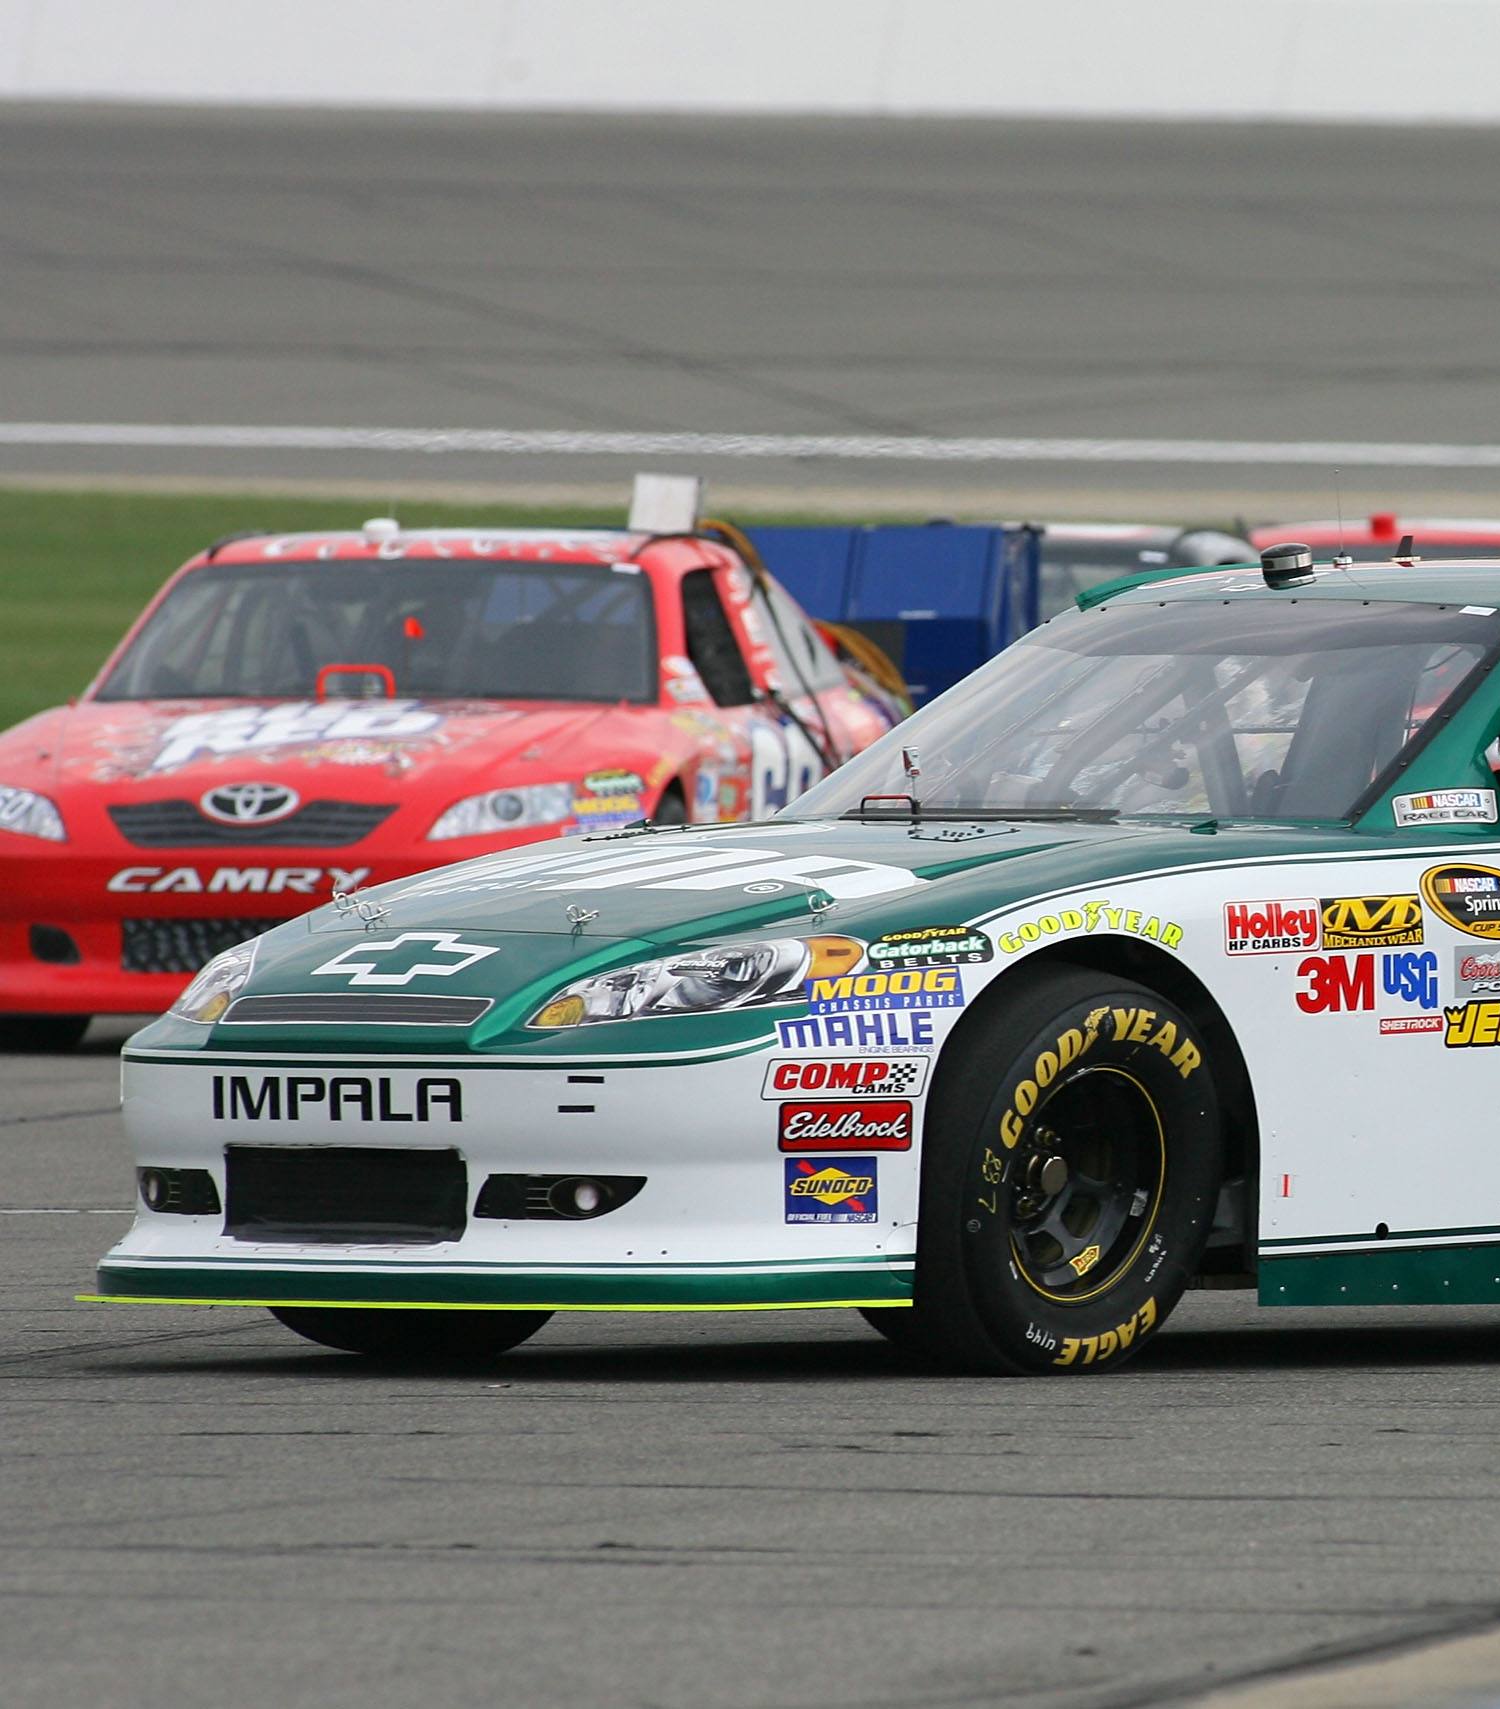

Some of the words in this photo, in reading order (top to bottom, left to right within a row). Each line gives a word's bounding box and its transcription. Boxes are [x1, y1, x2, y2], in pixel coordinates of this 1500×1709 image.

[1431, 793, 1481, 807] NASCAR
[1403, 811, 1450, 822] RACE
[1451, 809, 1489, 820] CAR
[107, 866, 372, 894] CAMRY
[1452, 877, 1497, 893] NASCAR
[881, 927, 968, 942] GOODYEAR
[999, 900, 1184, 954] GOODYEAR
[1228, 904, 1317, 947] Holley
[1472, 923, 1496, 933] CUP
[868, 935, 987, 959] Gatorback
[1228, 940, 1249, 950] HP
[1252, 936, 1302, 950] CARBS
[1323, 933, 1386, 949] MECHANIX
[1387, 929, 1424, 945] WEAR
[880, 952, 982, 969] BELTS
[811, 967, 959, 1002] MOOG
[1296, 954, 1375, 1014] 3M
[1383, 951, 1439, 1010] USG
[818, 997, 891, 1014] CHASSIS
[903, 993, 956, 1008] PARTS
[778, 1011, 935, 1049] MAHLE
[1380, 1018, 1442, 1032] SHEETROCK
[859, 1046, 891, 1054] ENGINE
[892, 1045, 935, 1054] BEARINGS
[773, 1062, 889, 1091] COMP
[1000, 1005, 1202, 1149] GOODYEAR
[212, 1075, 463, 1122] IMPALA
[852, 1083, 906, 1094] CAMS
[783, 1110, 909, 1141] Edelbrock
[793, 1178, 870, 1195] SUNOCO
[1052, 1296, 1157, 1366] EAGLE
